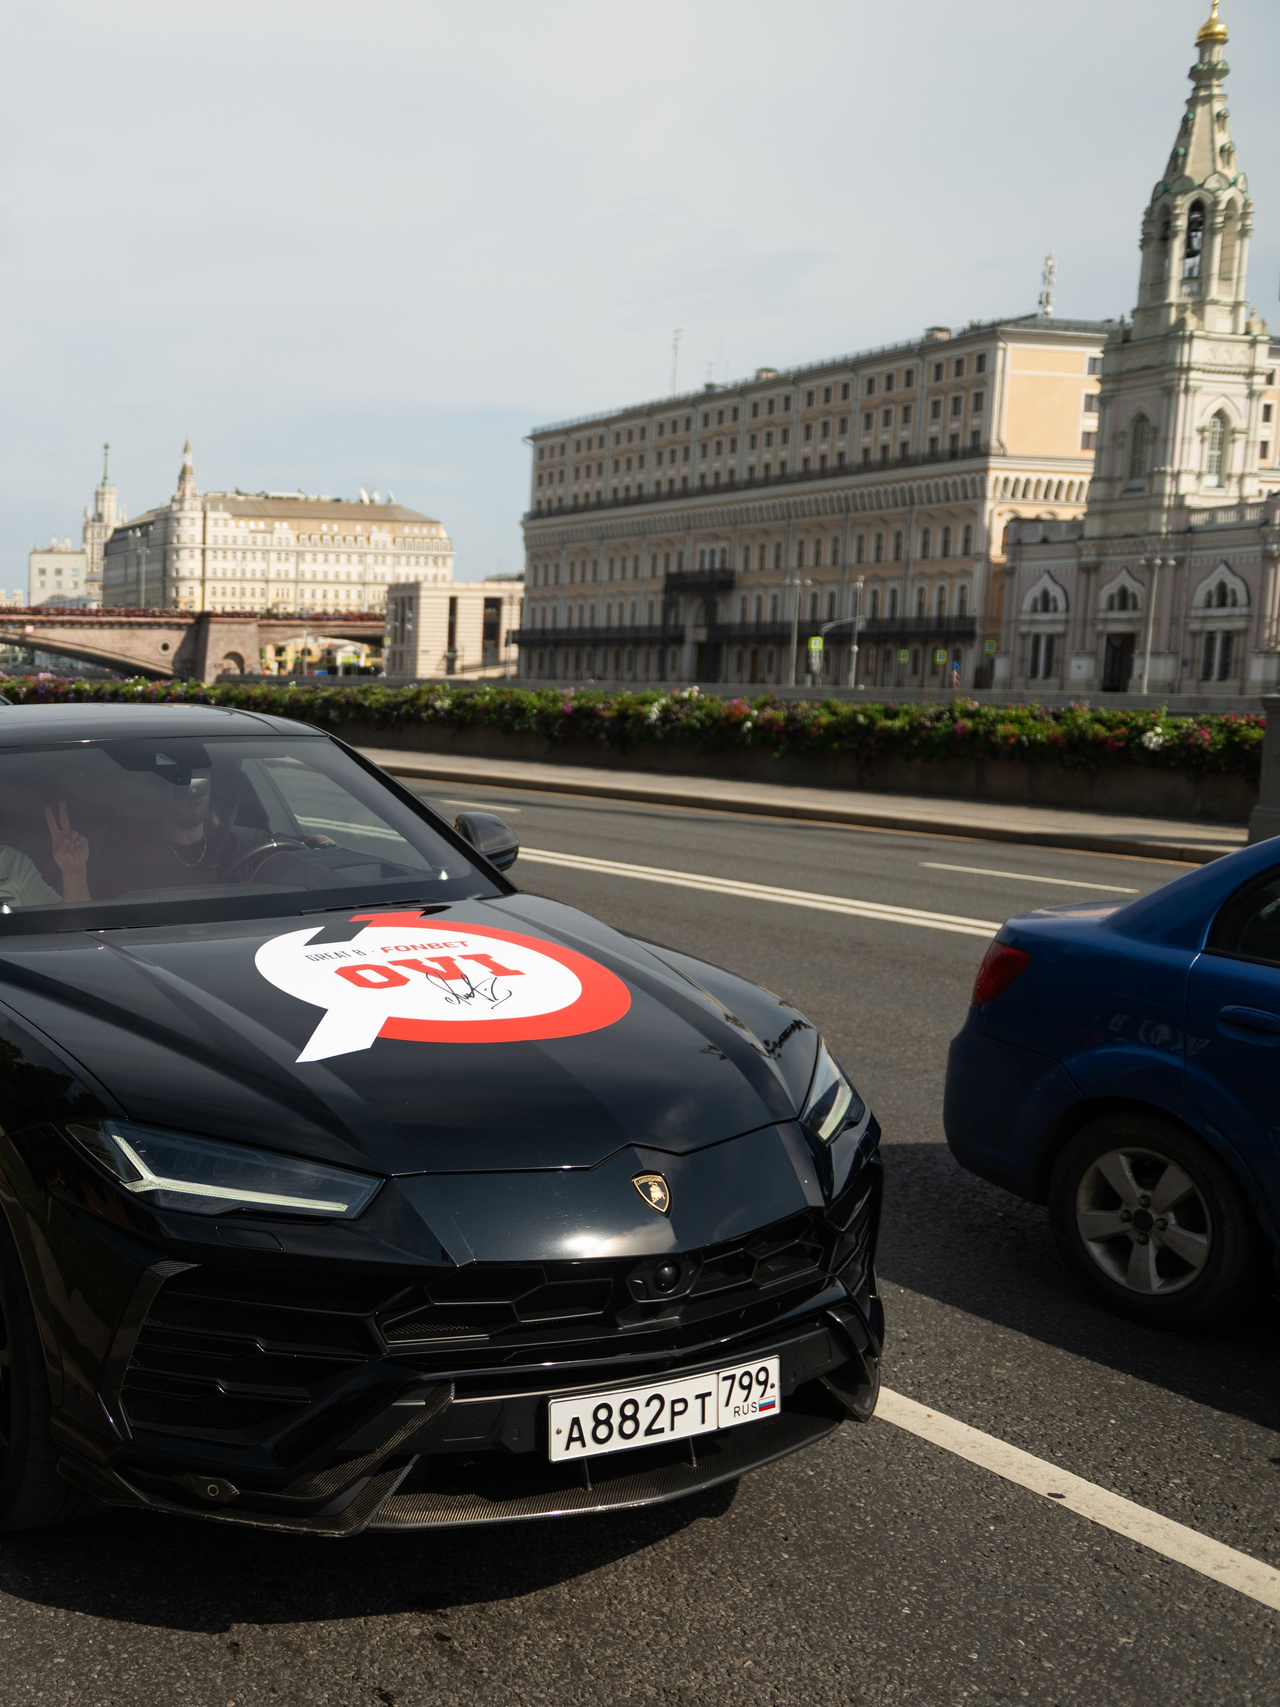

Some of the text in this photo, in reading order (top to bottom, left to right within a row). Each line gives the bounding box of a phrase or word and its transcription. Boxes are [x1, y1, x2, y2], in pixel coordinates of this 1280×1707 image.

[304, 950, 351, 962] GREAT
[380, 940, 469, 954] FONBET
[334, 952, 527, 990] OVI
[721, 1366, 770, 1408] 799
[733, 1401, 758, 1418] RUS
